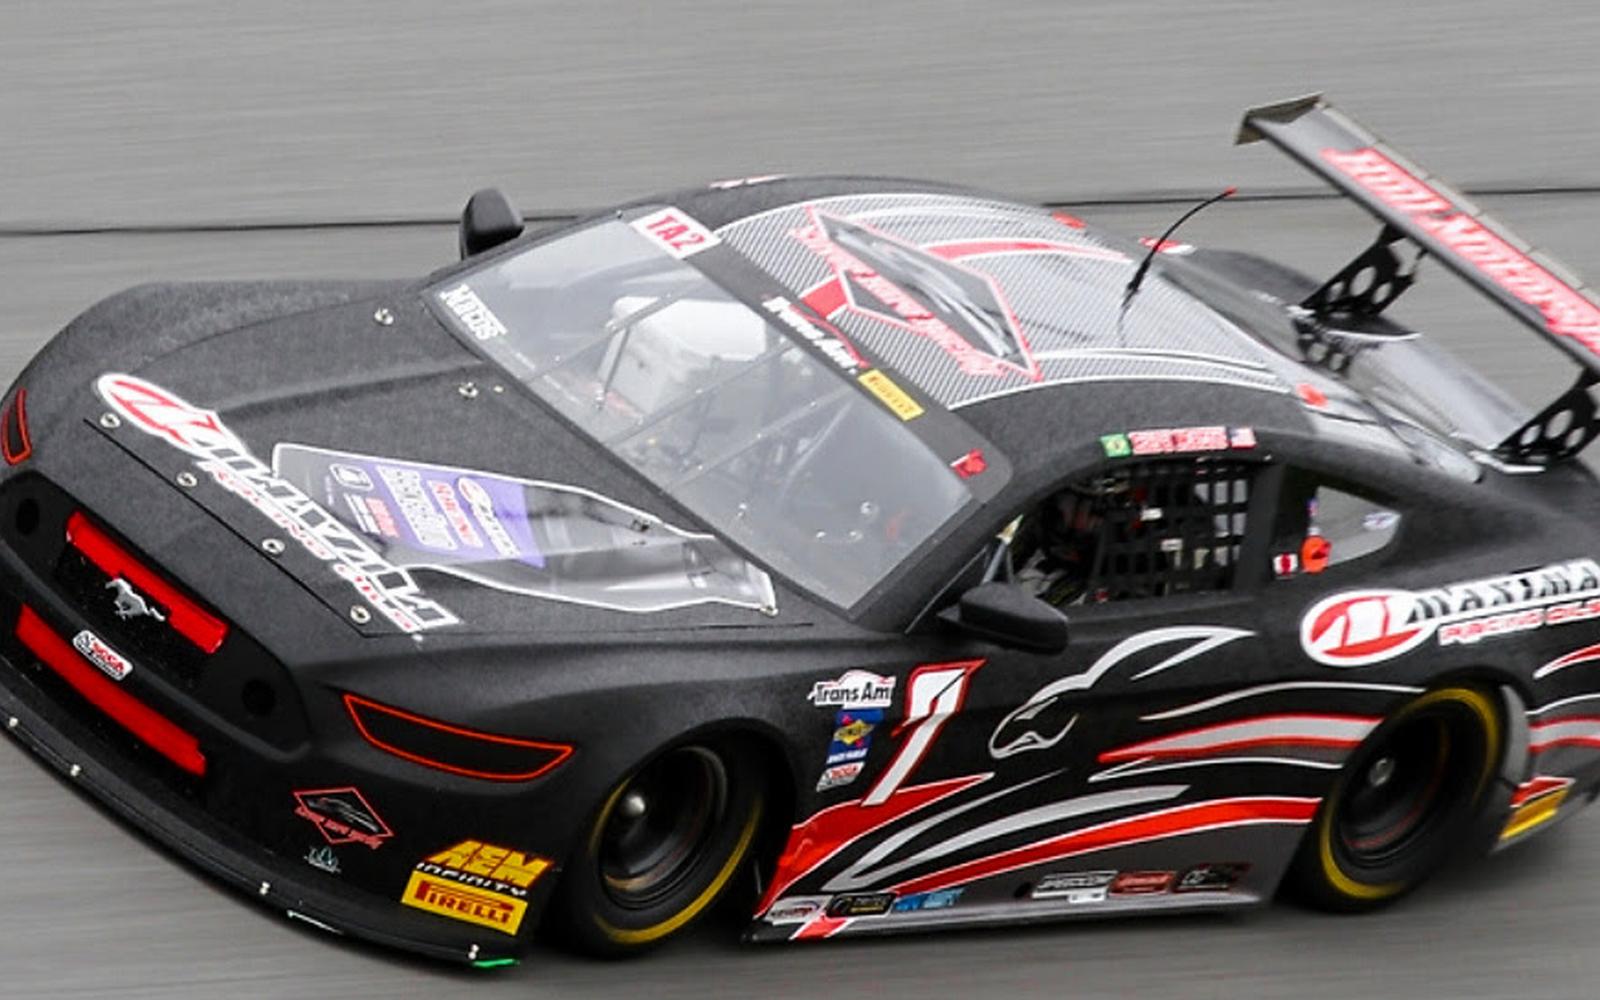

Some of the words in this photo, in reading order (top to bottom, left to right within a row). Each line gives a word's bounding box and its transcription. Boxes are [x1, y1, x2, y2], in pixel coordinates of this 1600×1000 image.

[646, 214, 706, 250] TA2
[814, 685, 859, 702] Trans
[861, 681, 891, 701] Am
[416, 862, 528, 896] INFINITY
[425, 839, 549, 889] AEM
[413, 880, 516, 925] PIRELLI
